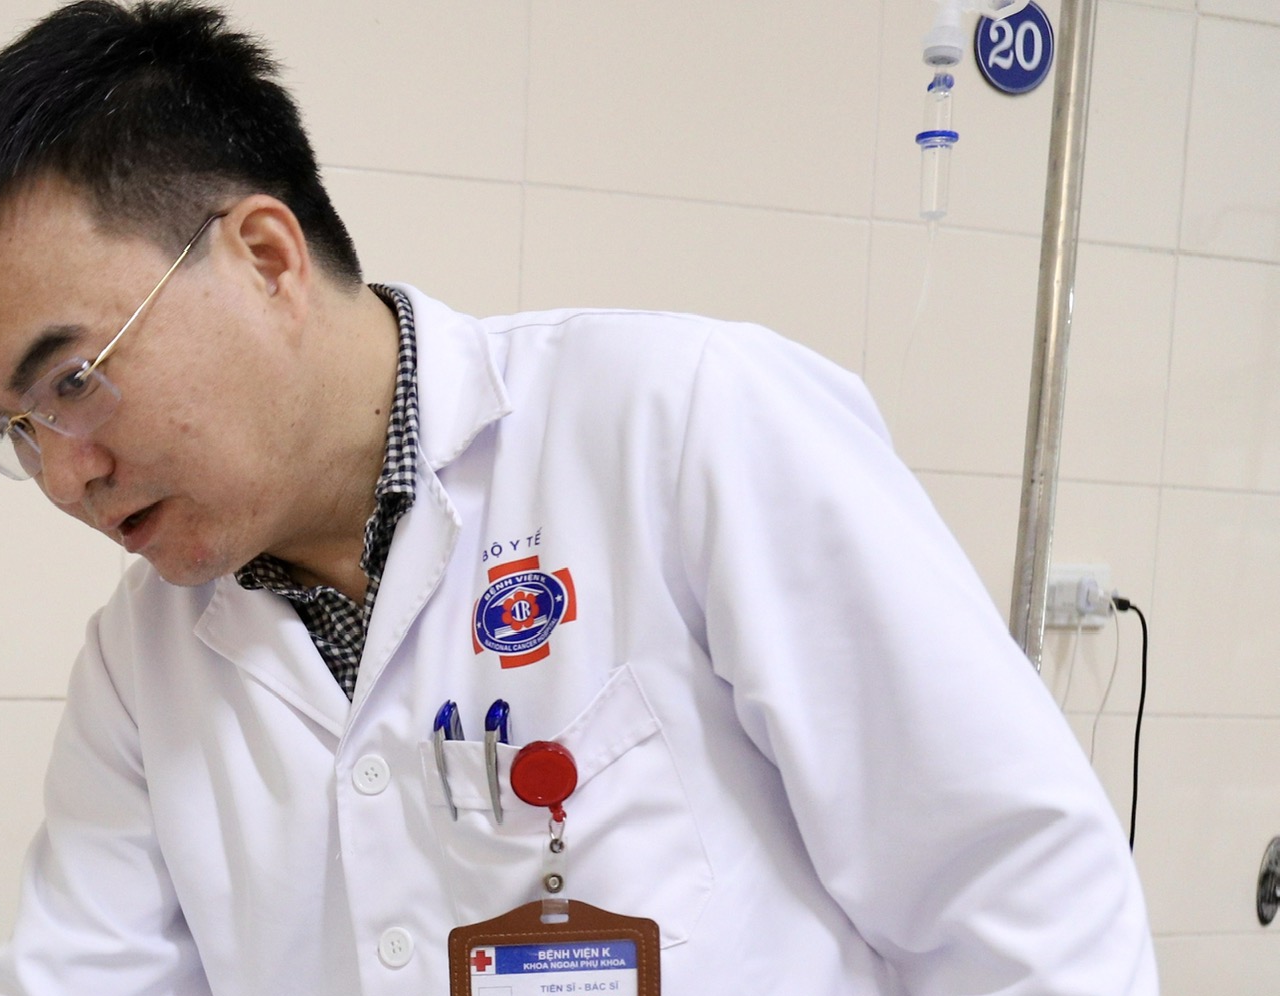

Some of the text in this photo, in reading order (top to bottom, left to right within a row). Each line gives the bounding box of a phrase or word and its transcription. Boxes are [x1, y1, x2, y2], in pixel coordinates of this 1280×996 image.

[988, 19, 1043, 71] 20
[482, 526, 543, 562] BỘ Y TẾ
[485, 639, 513, 652] NATIONAL
[512, 638, 538, 651] CANCER
[538, 947, 611, 961] BỆNH VIỆN K
[523, 962, 549, 970] KHOA
[550, 960, 578, 970] NGOẠI
[580, 960, 598, 968] PHỤ
[584, 981, 606, 991] BÁC
